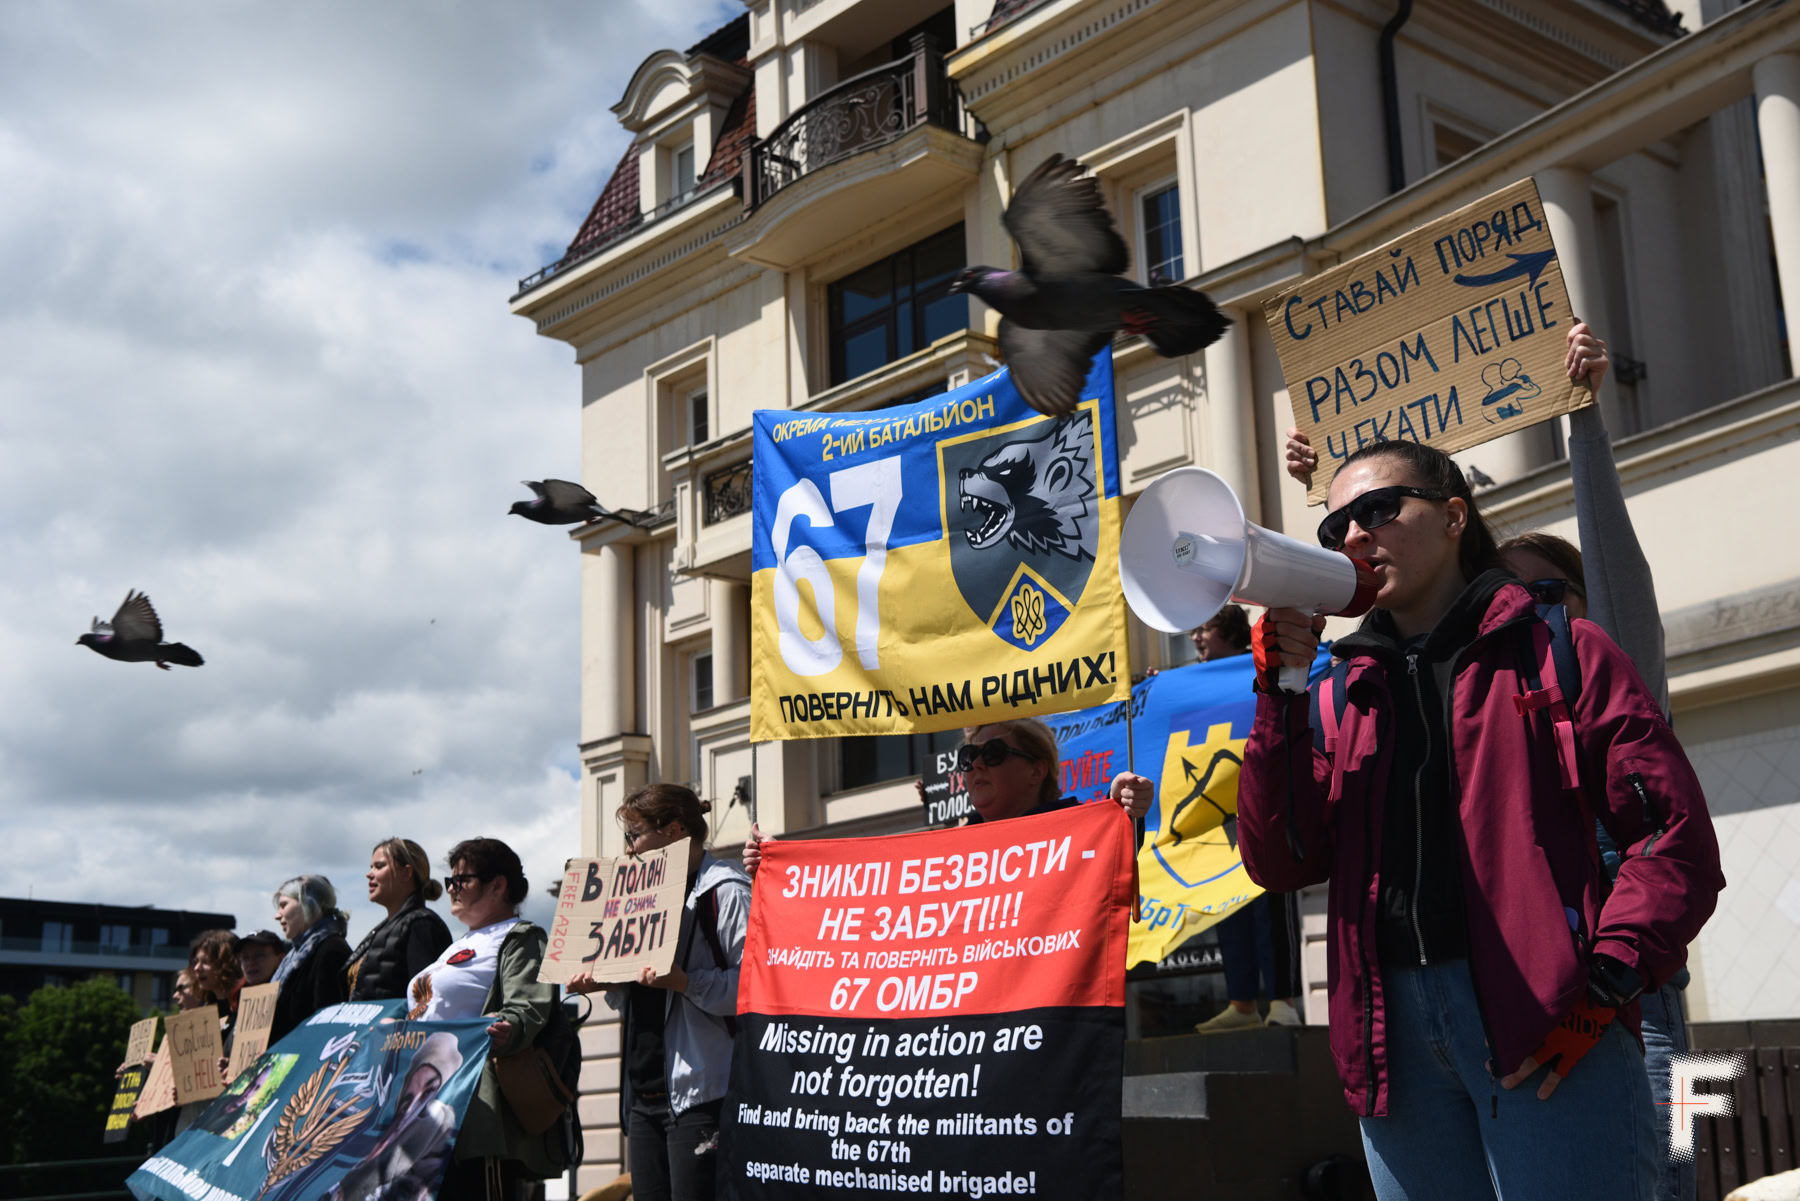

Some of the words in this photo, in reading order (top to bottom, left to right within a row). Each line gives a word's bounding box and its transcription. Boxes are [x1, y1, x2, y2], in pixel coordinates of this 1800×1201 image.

[1284, 249, 1420, 340] СТАВАЙ
[1434, 201, 1542, 274] ПОРЯД
[1306, 332, 1440, 424] РАЗОМ
[1452, 281, 1557, 363] ЛЕГШЕ
[822, 430, 866, 461] 2-ИЙ
[869, 395, 994, 449] БАТАЛЬЙОН
[1326, 385, 1463, 459] ЧЕКАТИ
[772, 455, 904, 676] 67
[779, 690, 909, 723] ПОВЕРНІТЬ
[909, 680, 974, 716] НАМ
[982, 651, 1117, 707] РІДНИХ!
[1058, 749, 1114, 795] ТУЙТЕ
[782, 862, 891, 898] ЗНИКЛІ
[899, 836, 1072, 894] БЕЗВІСТИ
[561, 872, 580, 909] FREE
[604, 898, 621, 919] НЕ
[817, 907, 865, 941] НЕ
[871, 891, 1024, 941] ЗАБУТІ!!!
[549, 915, 570, 963] AZOV
[767, 946, 835, 970] ЗНАЙДІТЬ
[840, 951, 860, 969] ТА
[863, 948, 958, 970] ПОВЕРНІТЬ
[962, 929, 1082, 963] ВІЙСЬКОВИХ
[829, 977, 866, 1011] 67
[876, 971, 978, 1012] ОМБР
[172, 1019, 214, 1064] Captivity
[759, 1022, 855, 1063] Missing
[862, 1026, 890, 1057] in
[895, 1024, 986, 1057] action
[993, 1024, 1043, 1053] are
[183, 1073, 192, 1093] is
[193, 1058, 217, 1091] HELL
[790, 1066, 832, 1096] not
[838, 1064, 981, 1107] forgotten!
[738, 1103, 761, 1125] Find
[763, 1107, 791, 1128] and
[795, 1108, 840, 1137] bring
[844, 1112, 891, 1135] back
[897, 1114, 929, 1136] the
[936, 1113, 1037, 1136] militants
[1046, 1112, 1074, 1136] of
[831, 1139, 861, 1162] the
[866, 1141, 911, 1164] 67th
[746, 1159, 810, 1185] separate
[815, 1167, 933, 1195] mechanised
[939, 1171, 1036, 1199] brigade!
